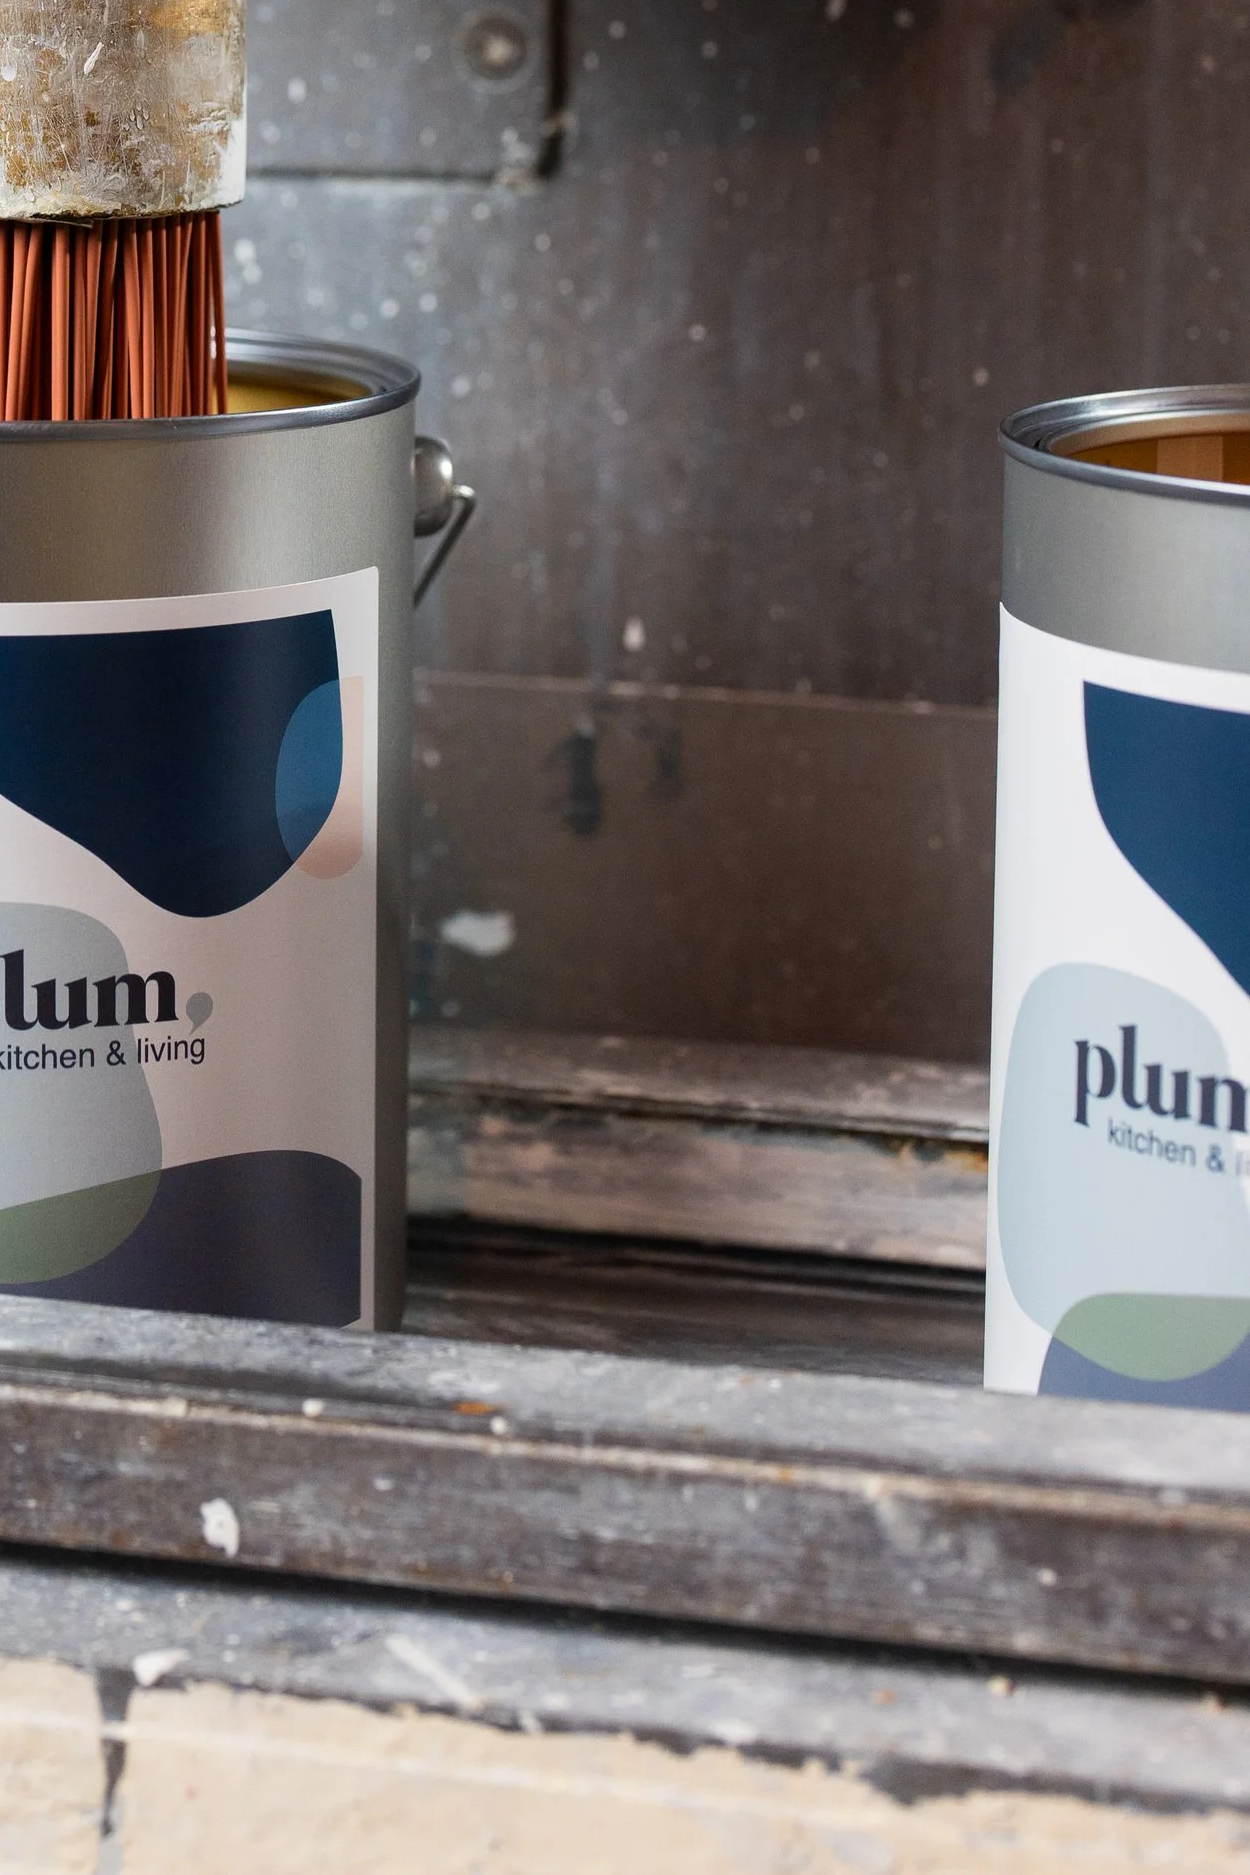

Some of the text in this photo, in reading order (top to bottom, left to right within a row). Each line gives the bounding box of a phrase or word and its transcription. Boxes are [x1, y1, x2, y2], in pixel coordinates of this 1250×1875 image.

[106, 1039, 127, 1067] &
[137, 1035, 206, 1065] living
[1107, 1116, 1197, 1167] kitchen
[1205, 1142, 1225, 1174] &
